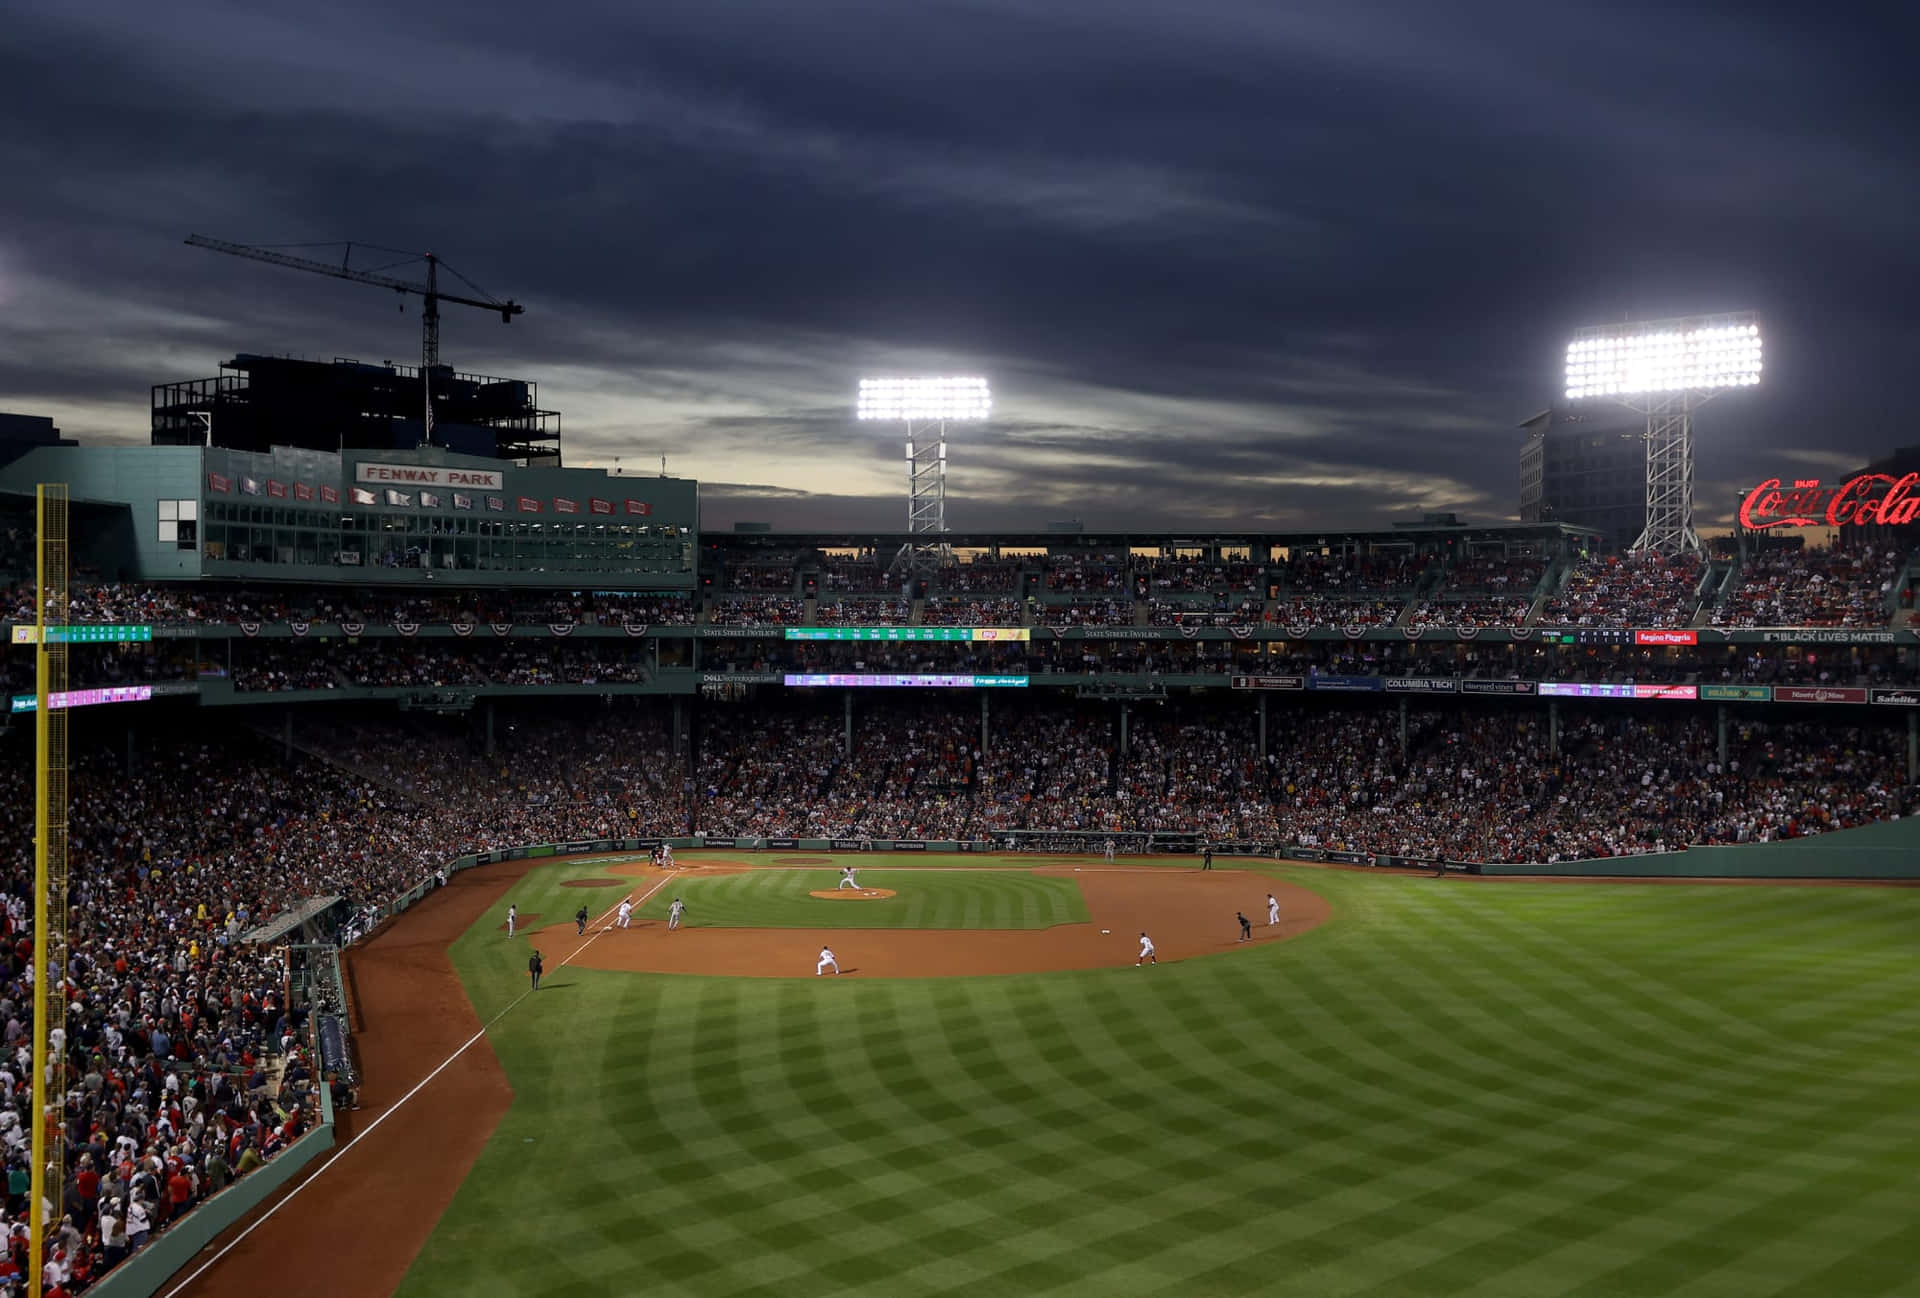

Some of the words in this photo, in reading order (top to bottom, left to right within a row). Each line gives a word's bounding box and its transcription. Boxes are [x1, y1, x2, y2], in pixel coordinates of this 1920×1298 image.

[367, 467, 438, 482] FENWAY
[449, 473, 495, 486] PARK
[1795, 480, 1820, 489] ENJOY
[1780, 633, 1815, 641] BLACK
[1818, 633, 1848, 641] LIVES
[1851, 634, 1894, 642] MATTER
[1432, 681, 1452, 689] TECH
